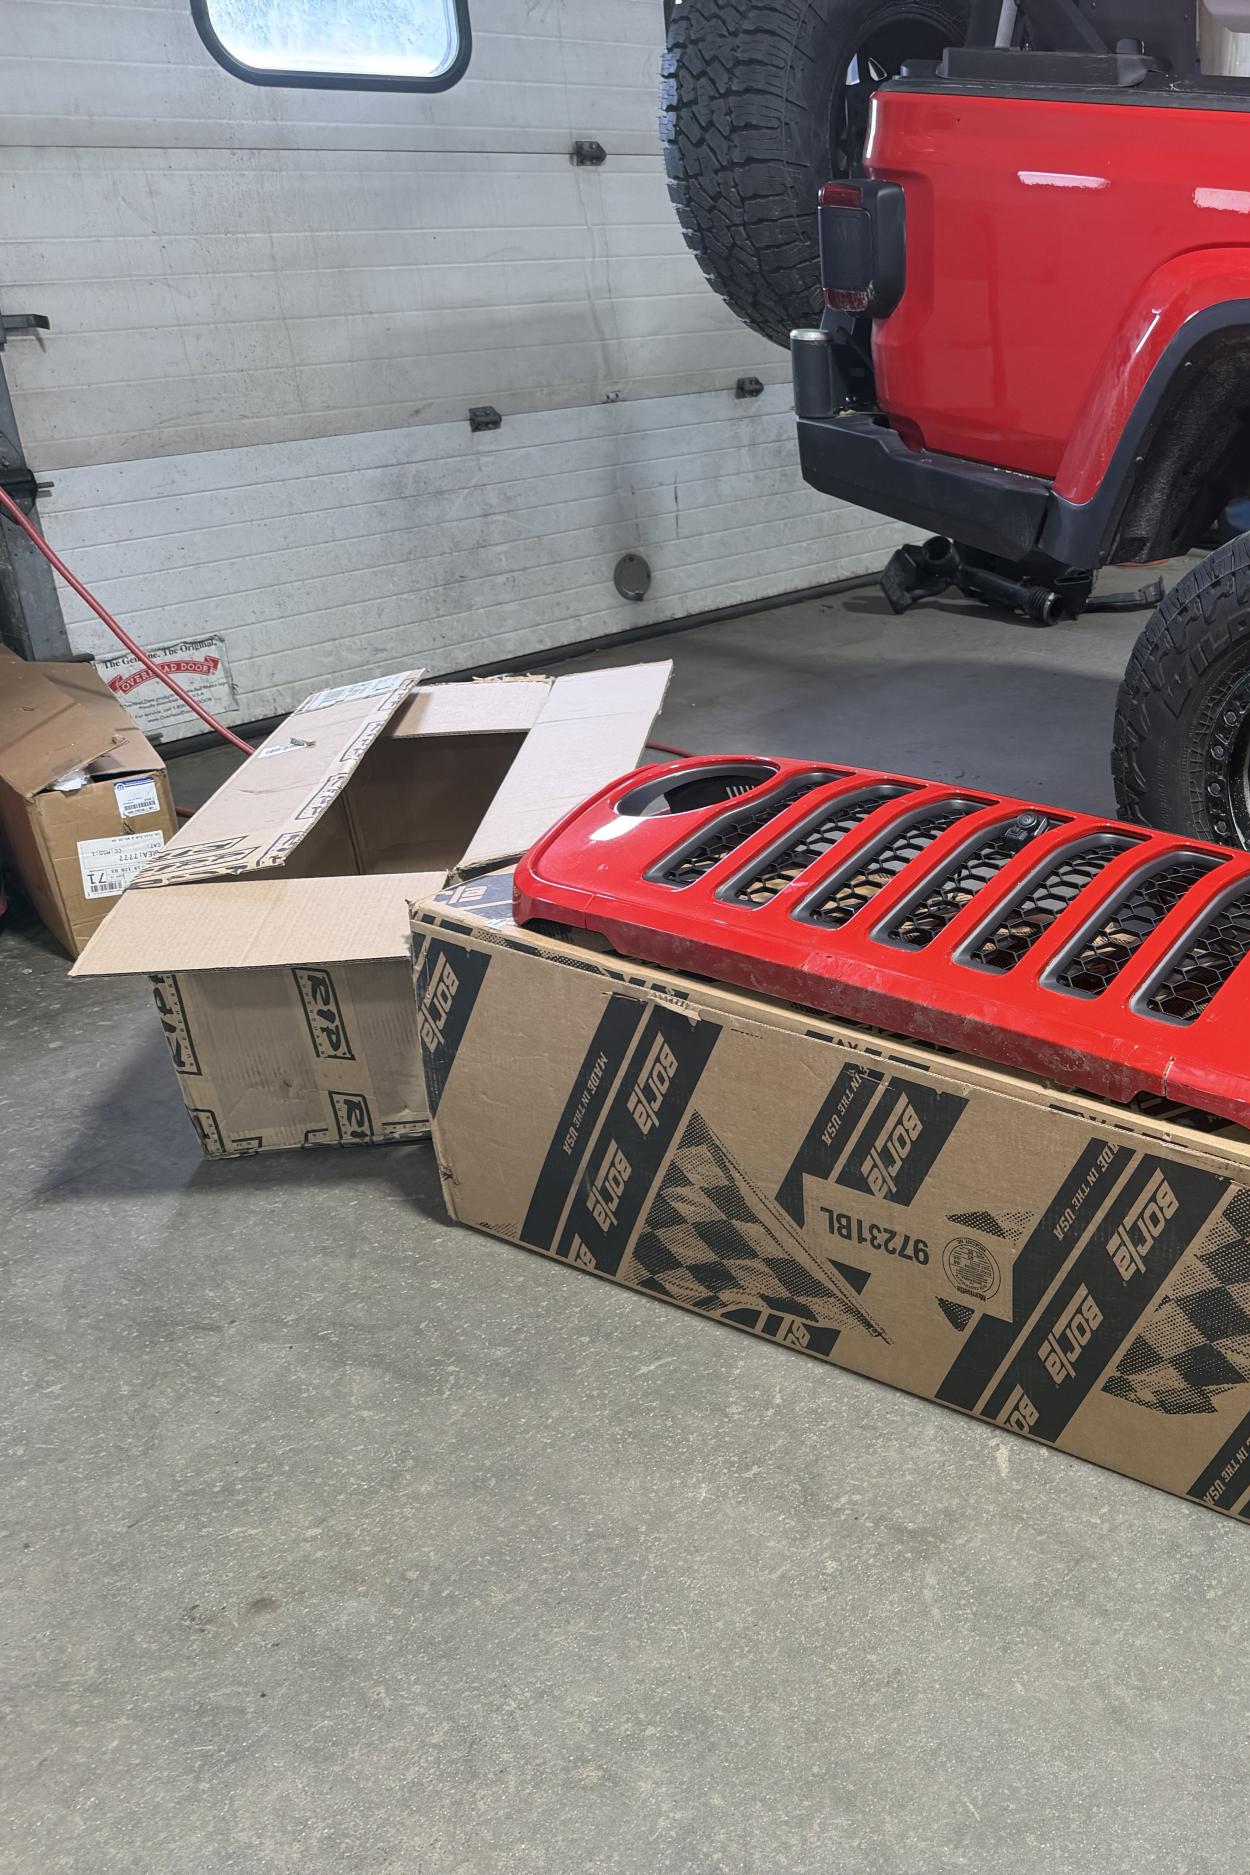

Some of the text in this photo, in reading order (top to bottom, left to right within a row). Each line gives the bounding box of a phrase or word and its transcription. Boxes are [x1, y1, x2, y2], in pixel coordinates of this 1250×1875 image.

[104, 659, 121, 670] The
[163, 647, 180, 657] The
[180, 639, 217, 653] Original.
[181, 662, 209, 674] DOOR
[87, 872, 107, 885] 71
[850, 1073, 862, 1093] IN
[563, 1051, 608, 1156] MADE IN THE USA
[837, 1089, 854, 1116] THE
[821, 1114, 842, 1147] USA
[1086, 1166, 1099, 1187] IN
[1071, 1182, 1090, 1210] THE
[820, 1206, 930, 1266] 97231BL
[1053, 1208, 1076, 1241] USA
[1235, 1446, 1249, 1464] IN
[1221, 1459, 1240, 1482] THE
[1202, 1479, 1226, 1505] USA
